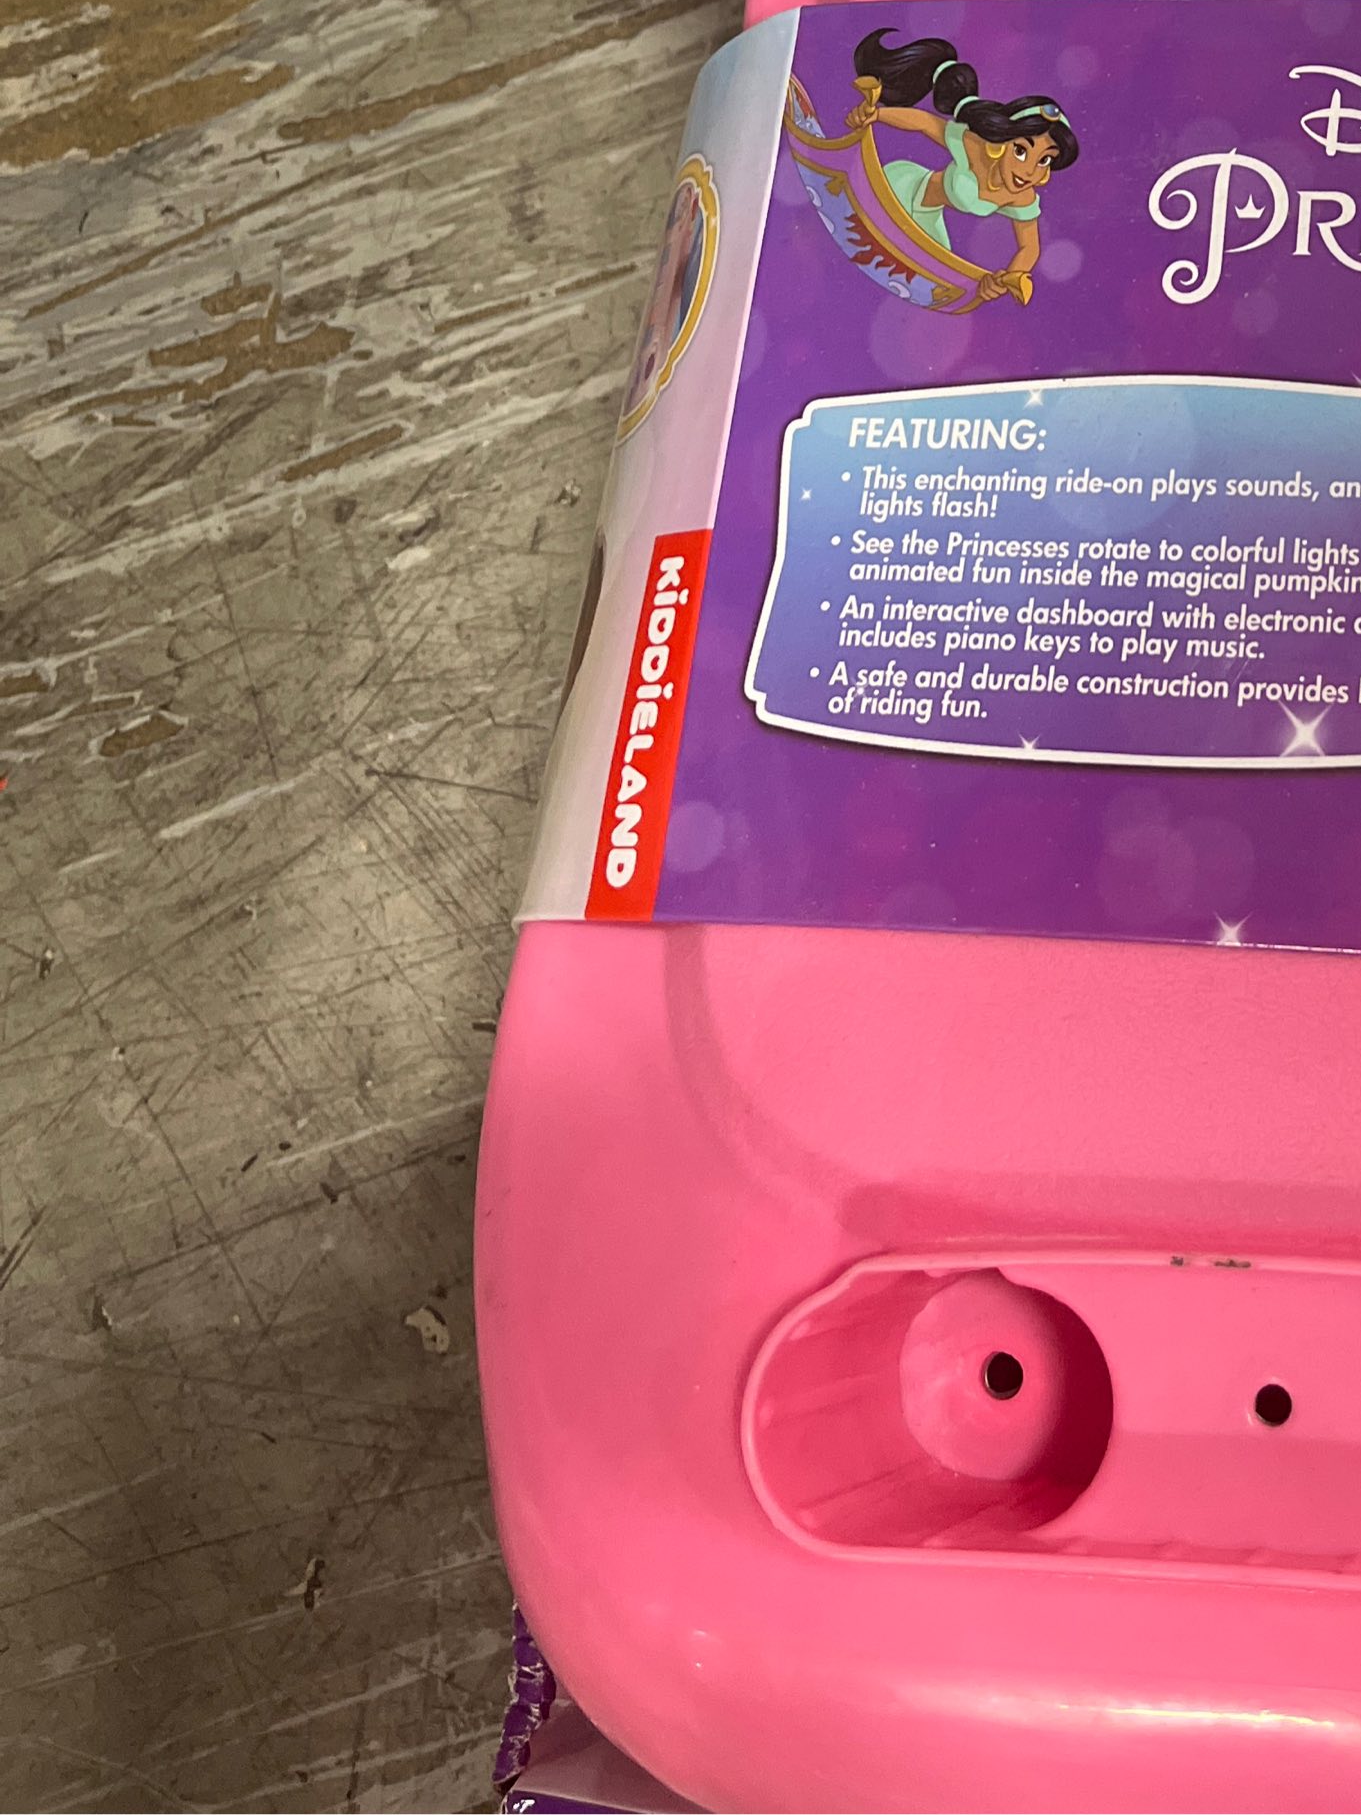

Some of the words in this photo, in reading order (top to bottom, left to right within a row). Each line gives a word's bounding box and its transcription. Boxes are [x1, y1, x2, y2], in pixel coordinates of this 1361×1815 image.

[849, 418, 1046, 451] FEATURING:
[863, 466, 907, 489] This
[915, 467, 1047, 499] enchanting
[1056, 468, 1143, 493] ride-on
[1150, 469, 1216, 502] plays
[1226, 471, 1319, 502] sounds,
[860, 492, 923, 523] lights
[932, 493, 998, 518] flash!
[850, 530, 893, 554] See
[902, 532, 939, 555] the
[947, 533, 1069, 559] Princesses
[1078, 539, 1151, 561] rotate
[1159, 540, 1183, 561] to
[1191, 536, 1284, 564] colorful
[1293, 538, 1359, 572] lights
[849, 558, 964, 583] animated
[971, 560, 1011, 583] fun
[1020, 561, 1092, 586] inside
[1100, 563, 1138, 587] the
[1147, 565, 1246, 596] magical
[839, 596, 874, 620] An
[882, 596, 1008, 624] interactive
[1017, 598, 1154, 628] dashboard
[1162, 601, 1215, 630] with
[1224, 604, 1346, 634] electronic
[839, 622, 936, 649] includes
[943, 626, 1016, 655] piano
[1025, 626, 1080, 659] keys
[1089, 631, 1113, 654] to
[1121, 629, 1178, 662] play
[1186, 635, 1264, 659] music.
[829, 661, 849, 686] A
[856, 661, 908, 687] safe
[915, 663, 964, 689] and
[971, 666, 1068, 693] durable
[1076, 673, 1229, 699] construction
[1237, 675, 1349, 707] provides
[828, 688, 854, 714] of
[859, 690, 933, 724] riding
[940, 691, 988, 718] fun.
